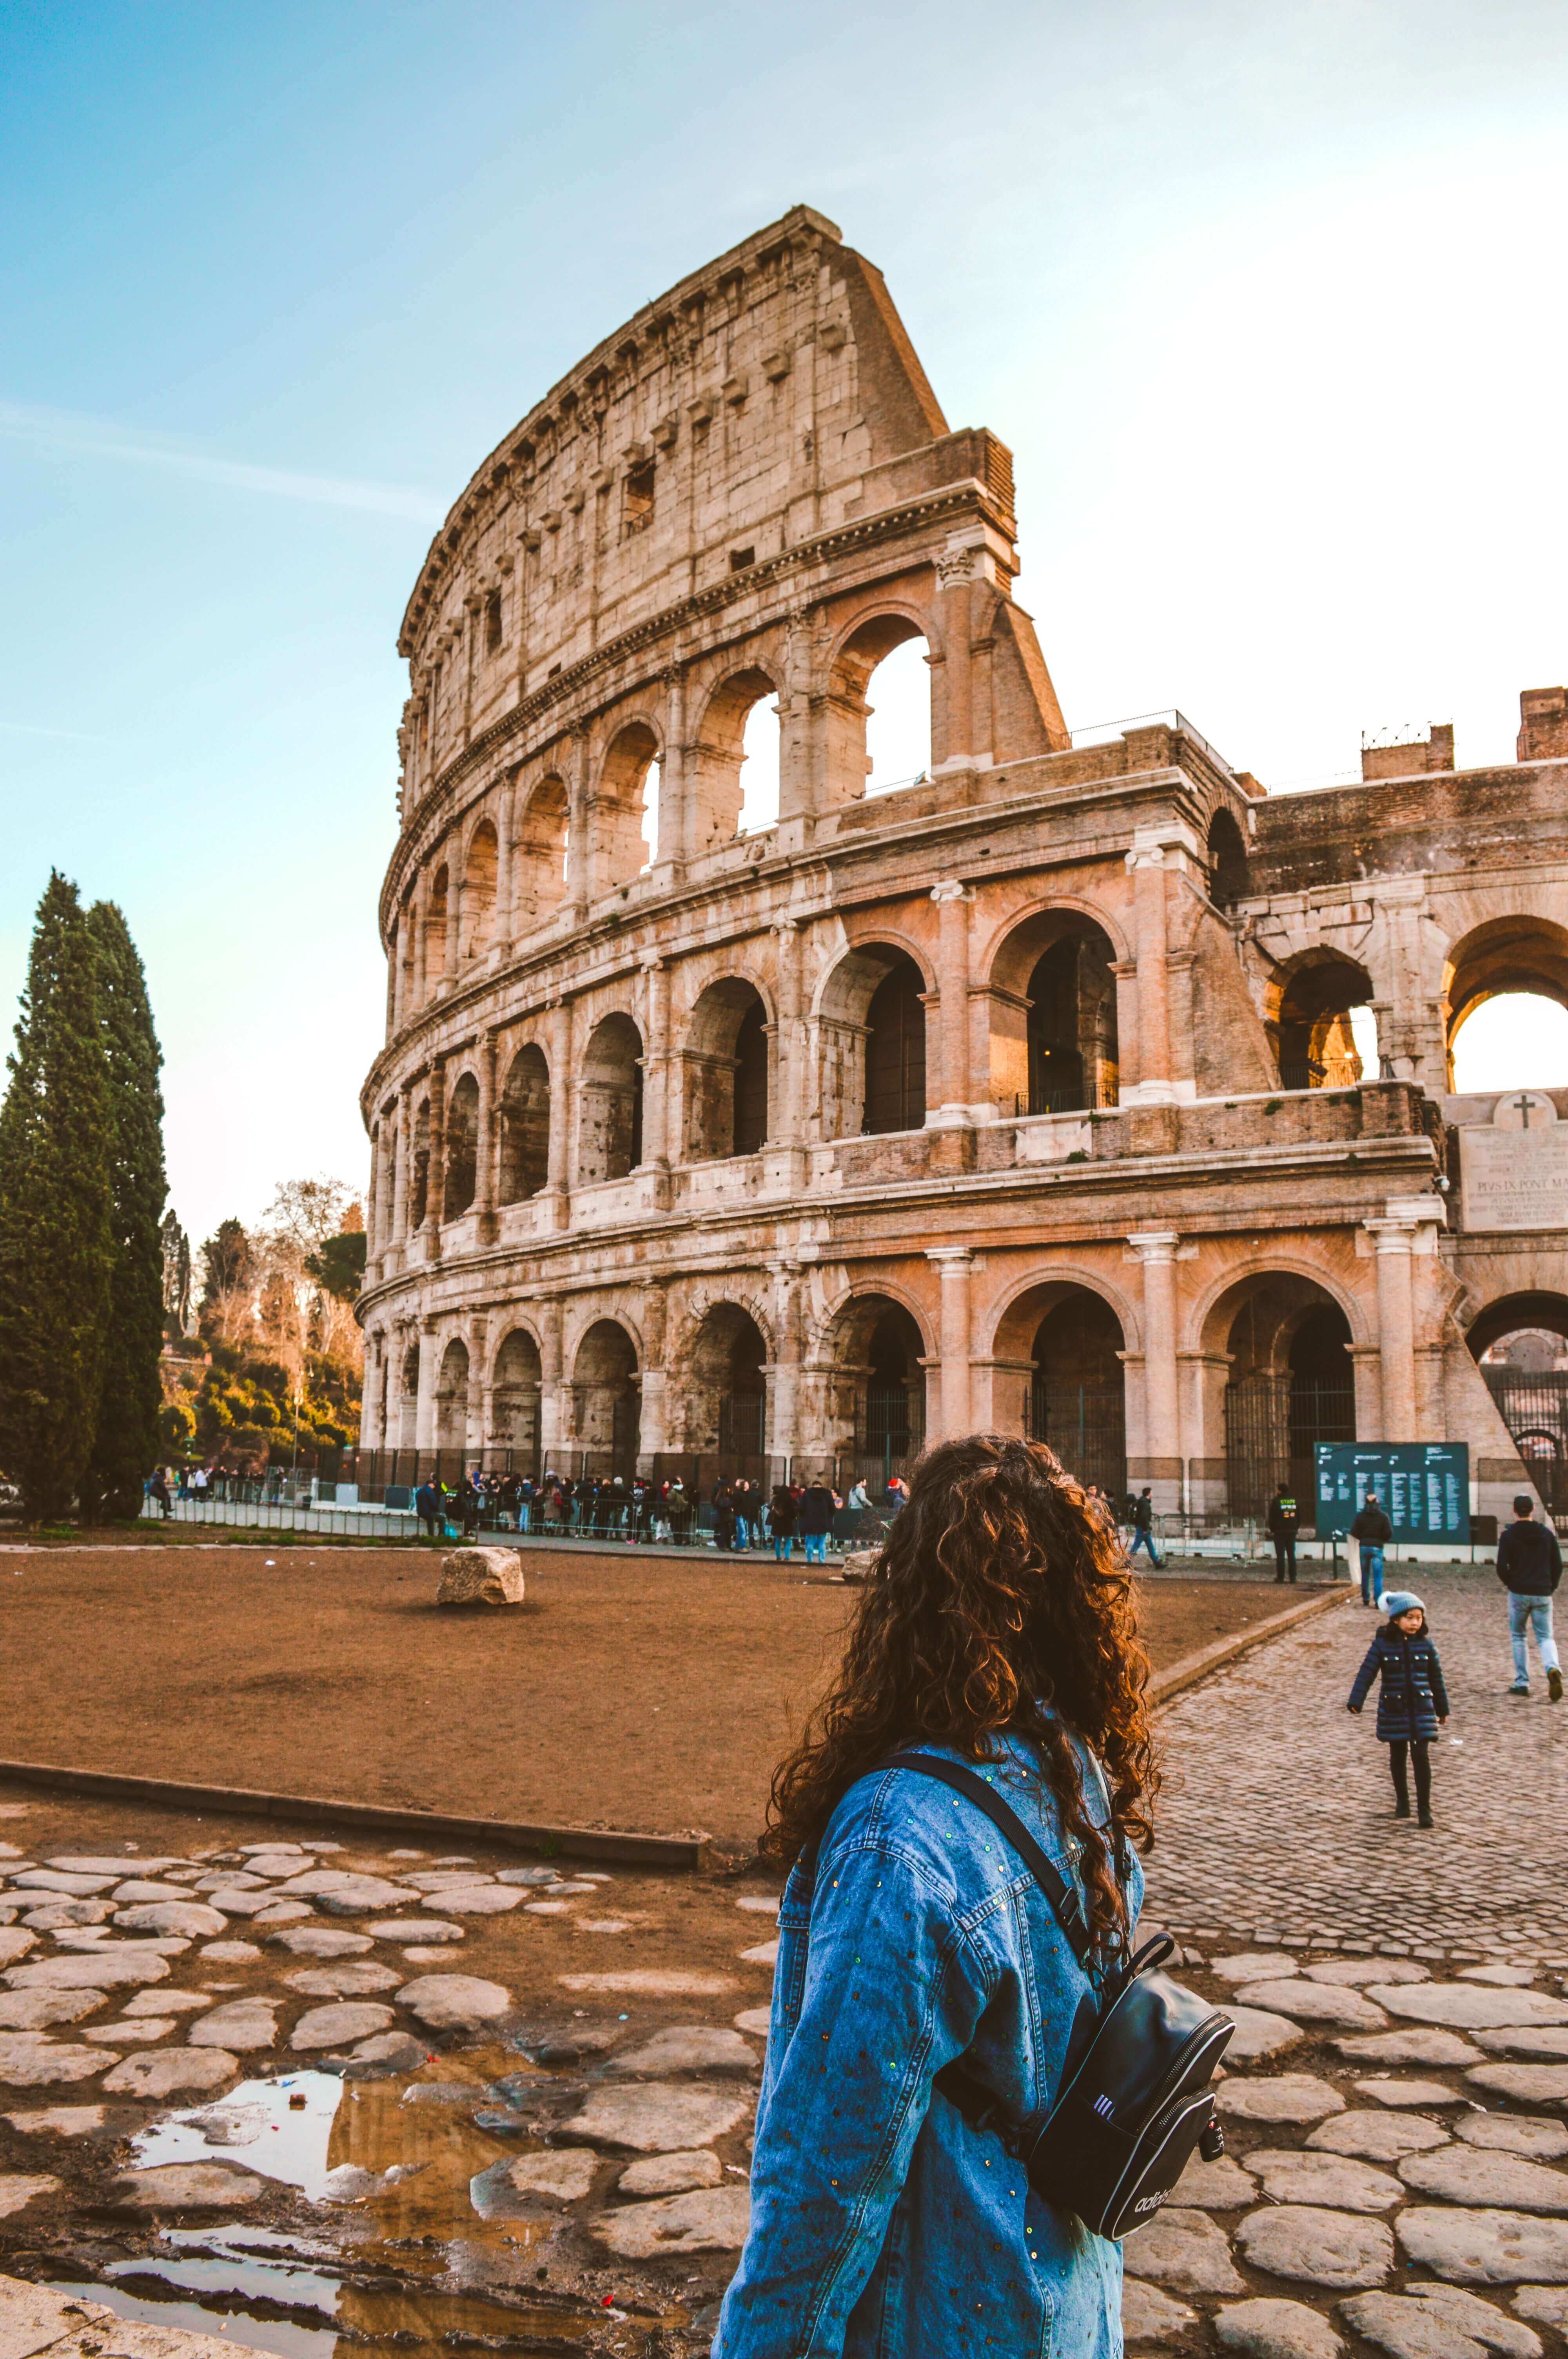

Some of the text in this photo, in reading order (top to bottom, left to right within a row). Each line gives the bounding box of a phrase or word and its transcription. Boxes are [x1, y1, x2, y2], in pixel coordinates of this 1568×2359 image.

[1477, 1181, 1502, 1191] PIVS
[1504, 1180, 1516, 1190] IX
[1519, 1179, 1547, 1189] PONT
